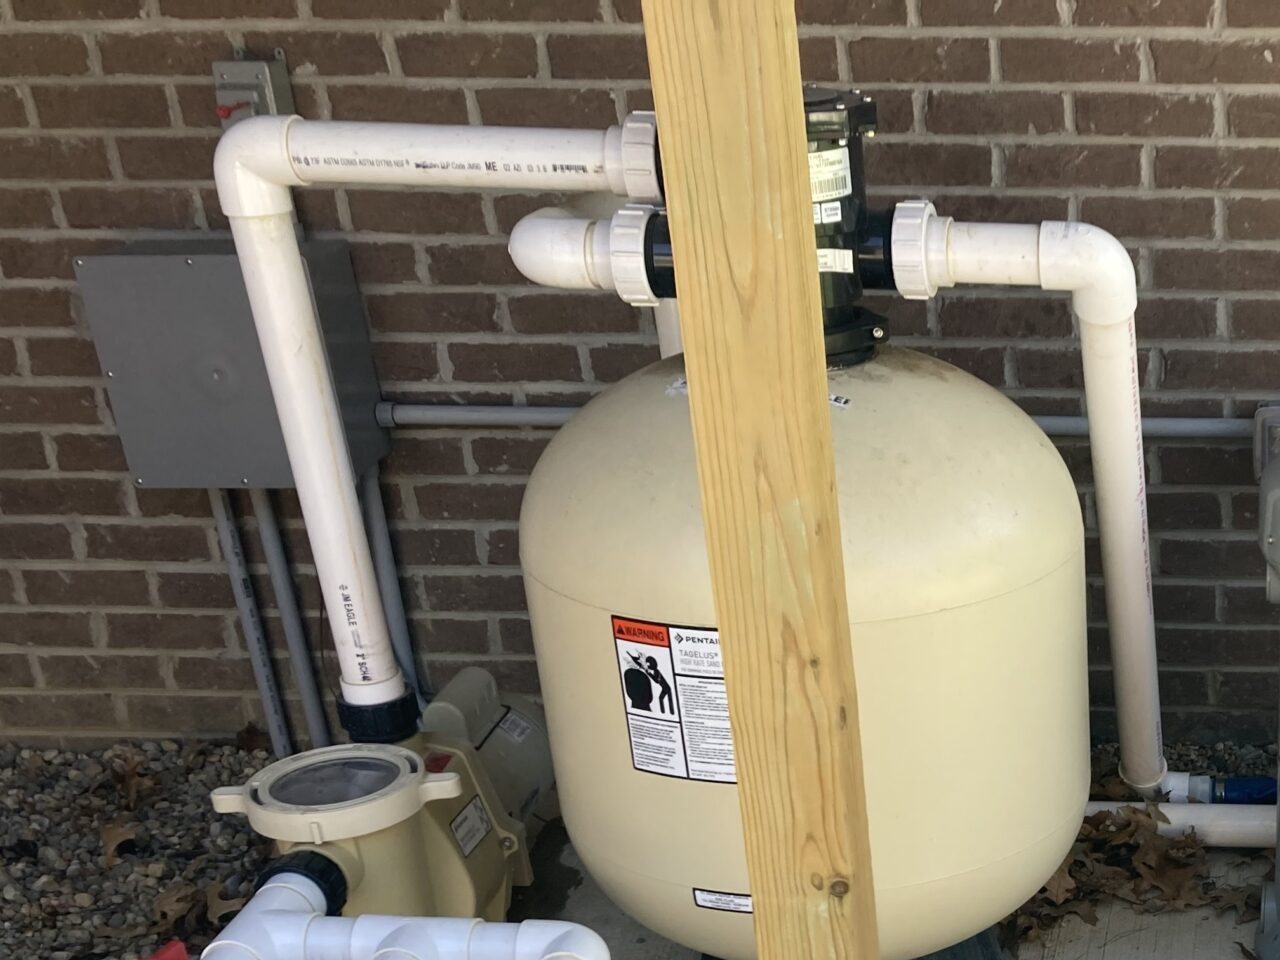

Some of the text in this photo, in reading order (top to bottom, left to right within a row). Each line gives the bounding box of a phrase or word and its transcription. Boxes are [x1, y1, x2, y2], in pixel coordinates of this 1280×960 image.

[485, 161, 499, 172] ME
[343, 603, 358, 627] EAGLE
[624, 626, 664, 642] WARNING
[685, 636, 720, 645] PENTAI
